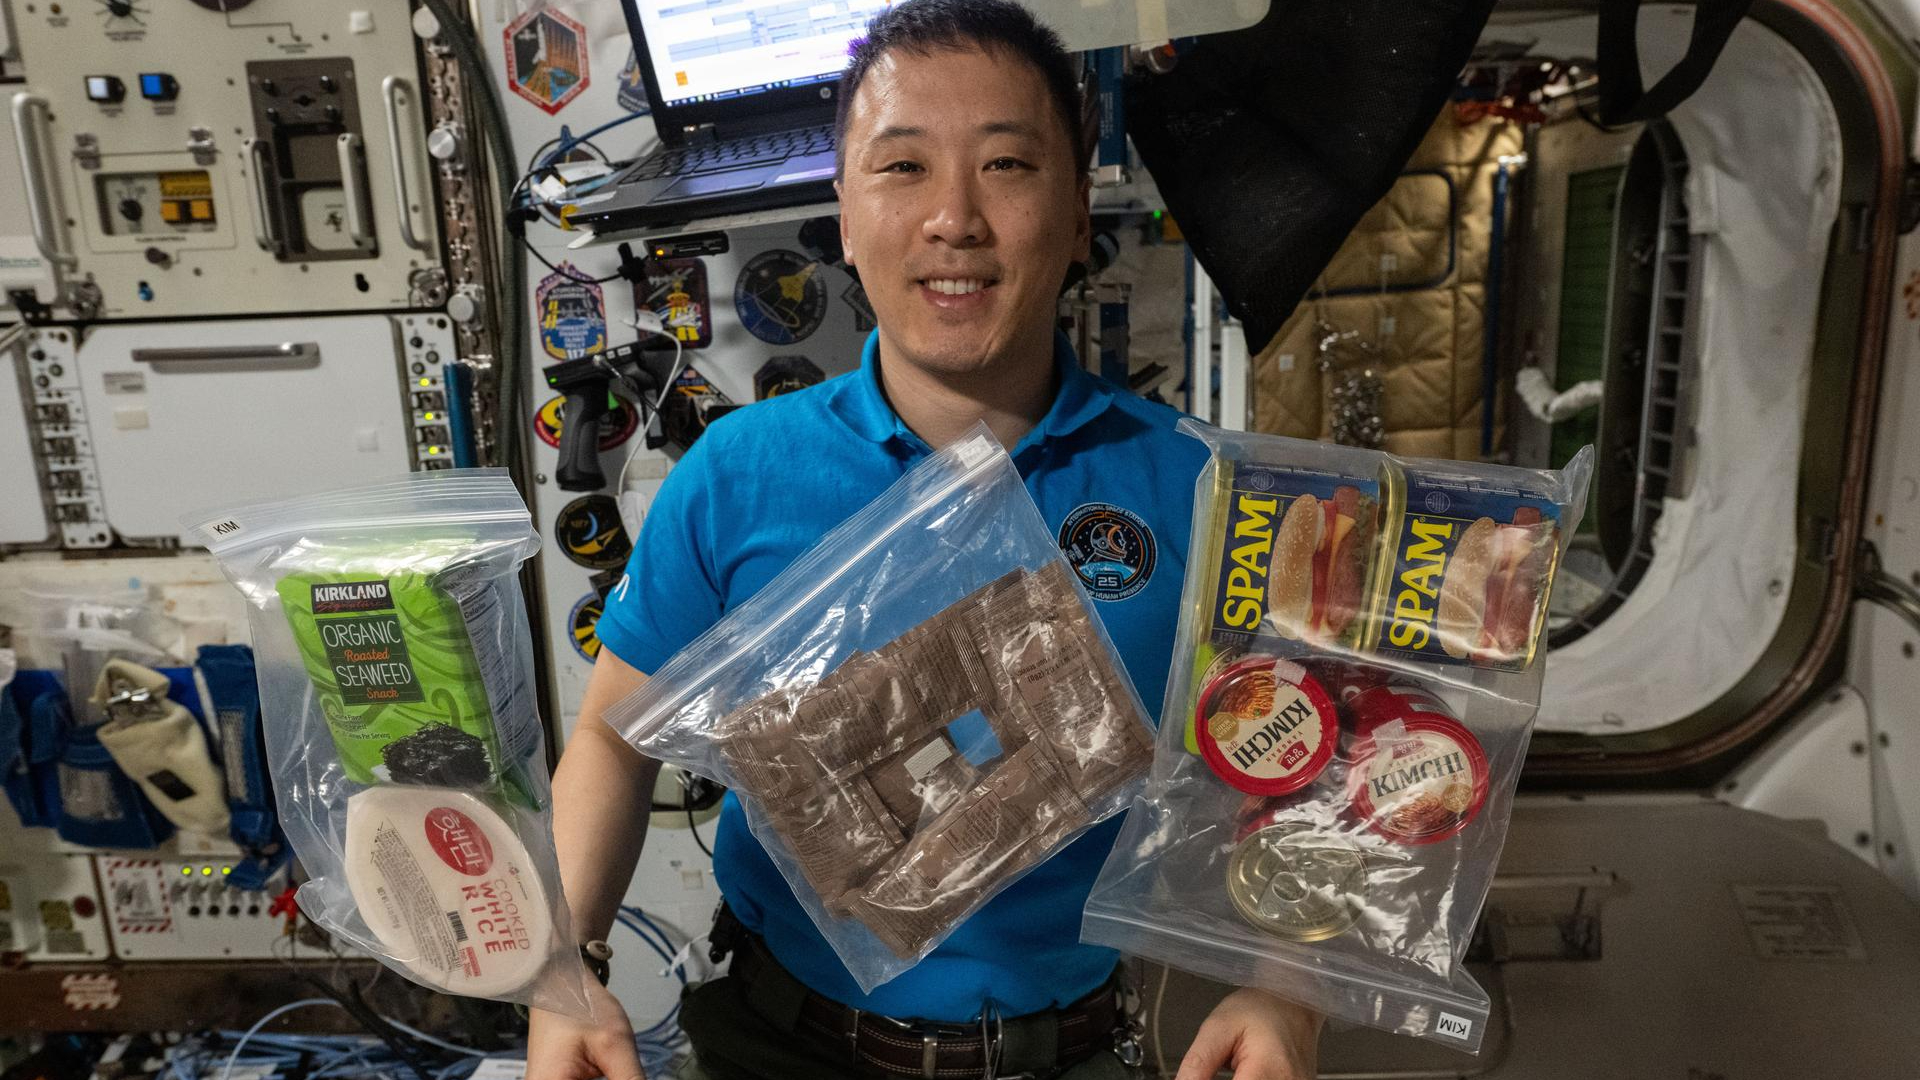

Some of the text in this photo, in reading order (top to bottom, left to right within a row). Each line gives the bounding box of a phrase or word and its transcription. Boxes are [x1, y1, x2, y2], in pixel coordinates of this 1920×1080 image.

[213, 519, 240, 537] KIM
[1066, 505, 1146, 528] INTERNATIONAL SPACE STATION
[1223, 495, 1277, 630] SPAM
[315, 584, 387, 602] KIRKLAND
[1095, 592, 1119, 600] HUMAN
[1119, 578, 1147, 599] PRESENCE
[1097, 577, 1118, 587] 25
[1390, 519, 1453, 650] SPAM
[322, 620, 401, 648] ORGANIC
[344, 648, 390, 662] Roasted
[335, 663, 411, 687] SEAWEED
[366, 687, 400, 700] Snack
[1233, 698, 1313, 770] KIMCHI
[1371, 751, 1465, 798] KIMCHI
[432, 813, 483, 869] 햇반
[461, 885, 503, 955] RICE
[480, 880, 517, 951] WHITE
[494, 878, 530, 950] COOKED
[1440, 1018, 1467, 1036] KIM
